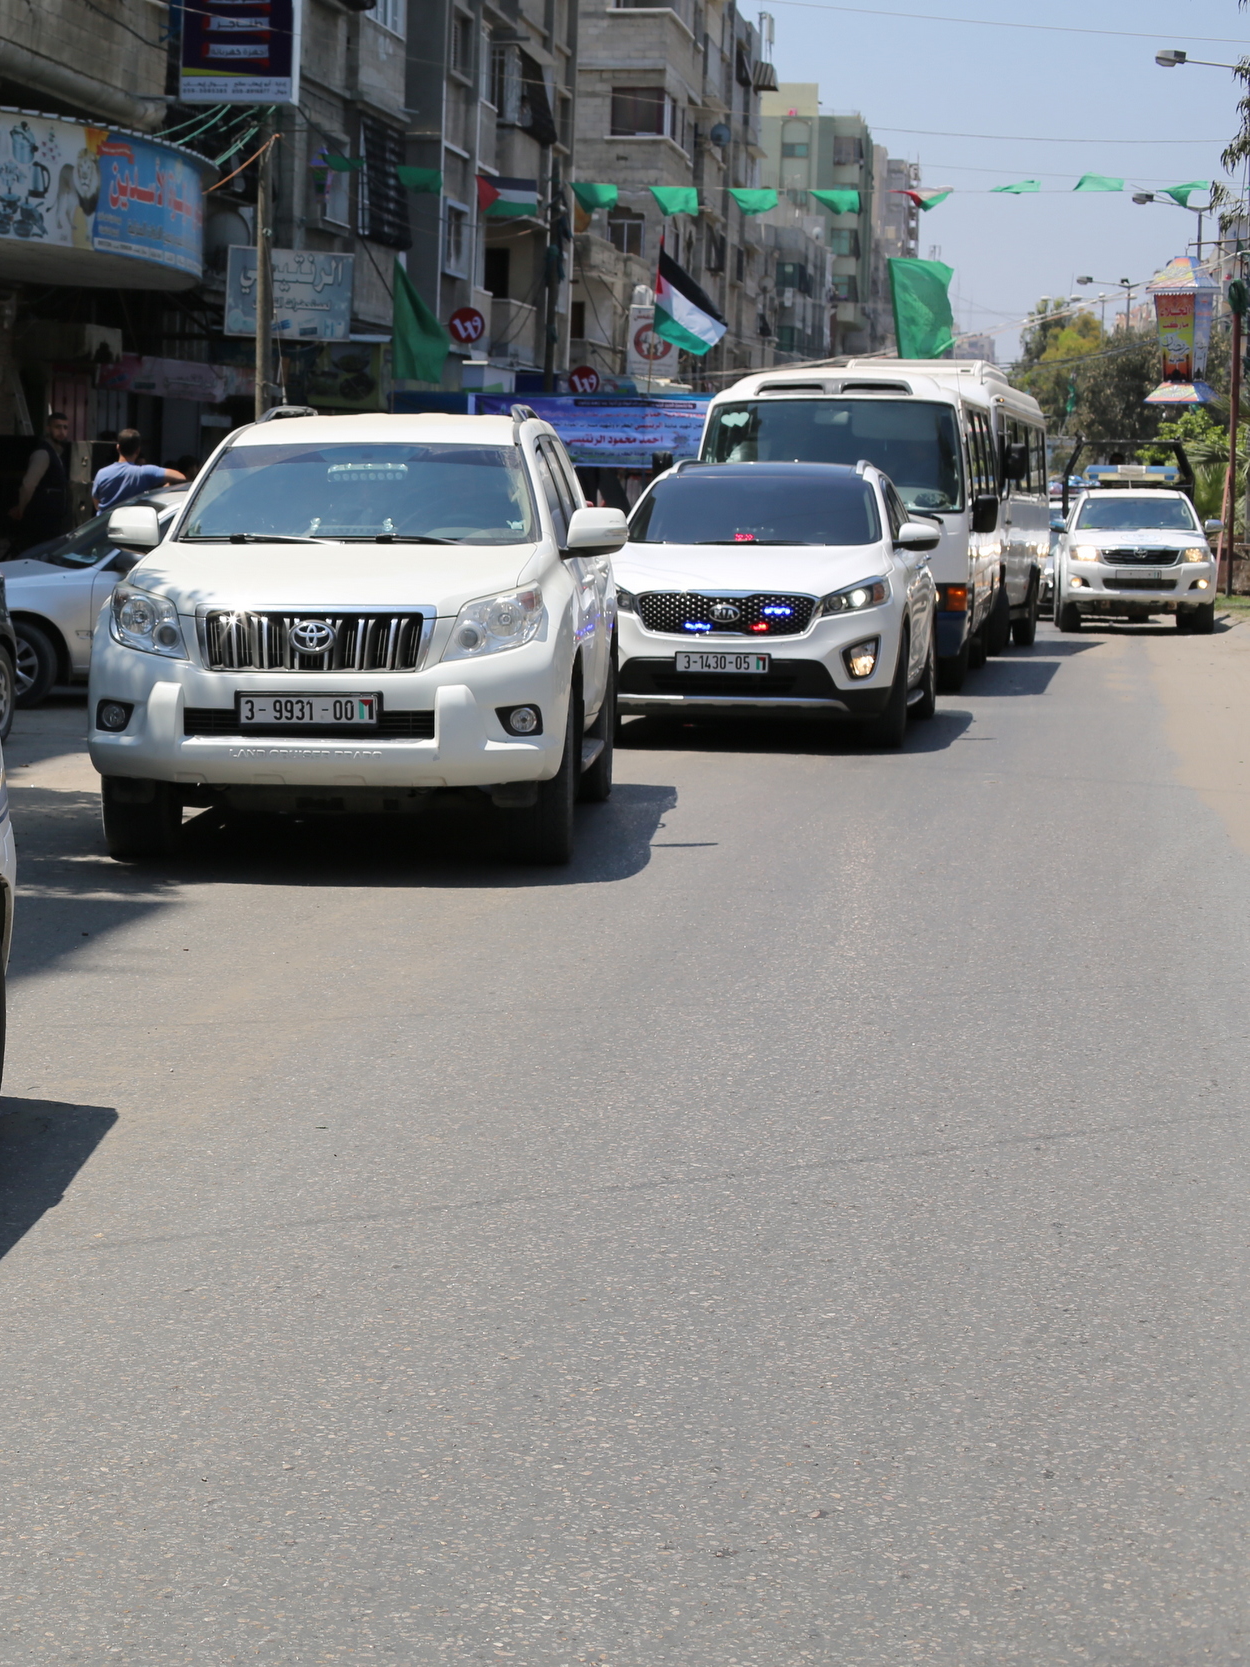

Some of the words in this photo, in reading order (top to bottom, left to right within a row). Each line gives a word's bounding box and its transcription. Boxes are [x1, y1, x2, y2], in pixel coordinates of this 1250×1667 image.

[565, 433, 606, 447] الرنتيسي
[607, 436, 636, 447] محمود
[713, 608, 735, 619] KIA
[684, 655, 750, 671] 3-1430-05
